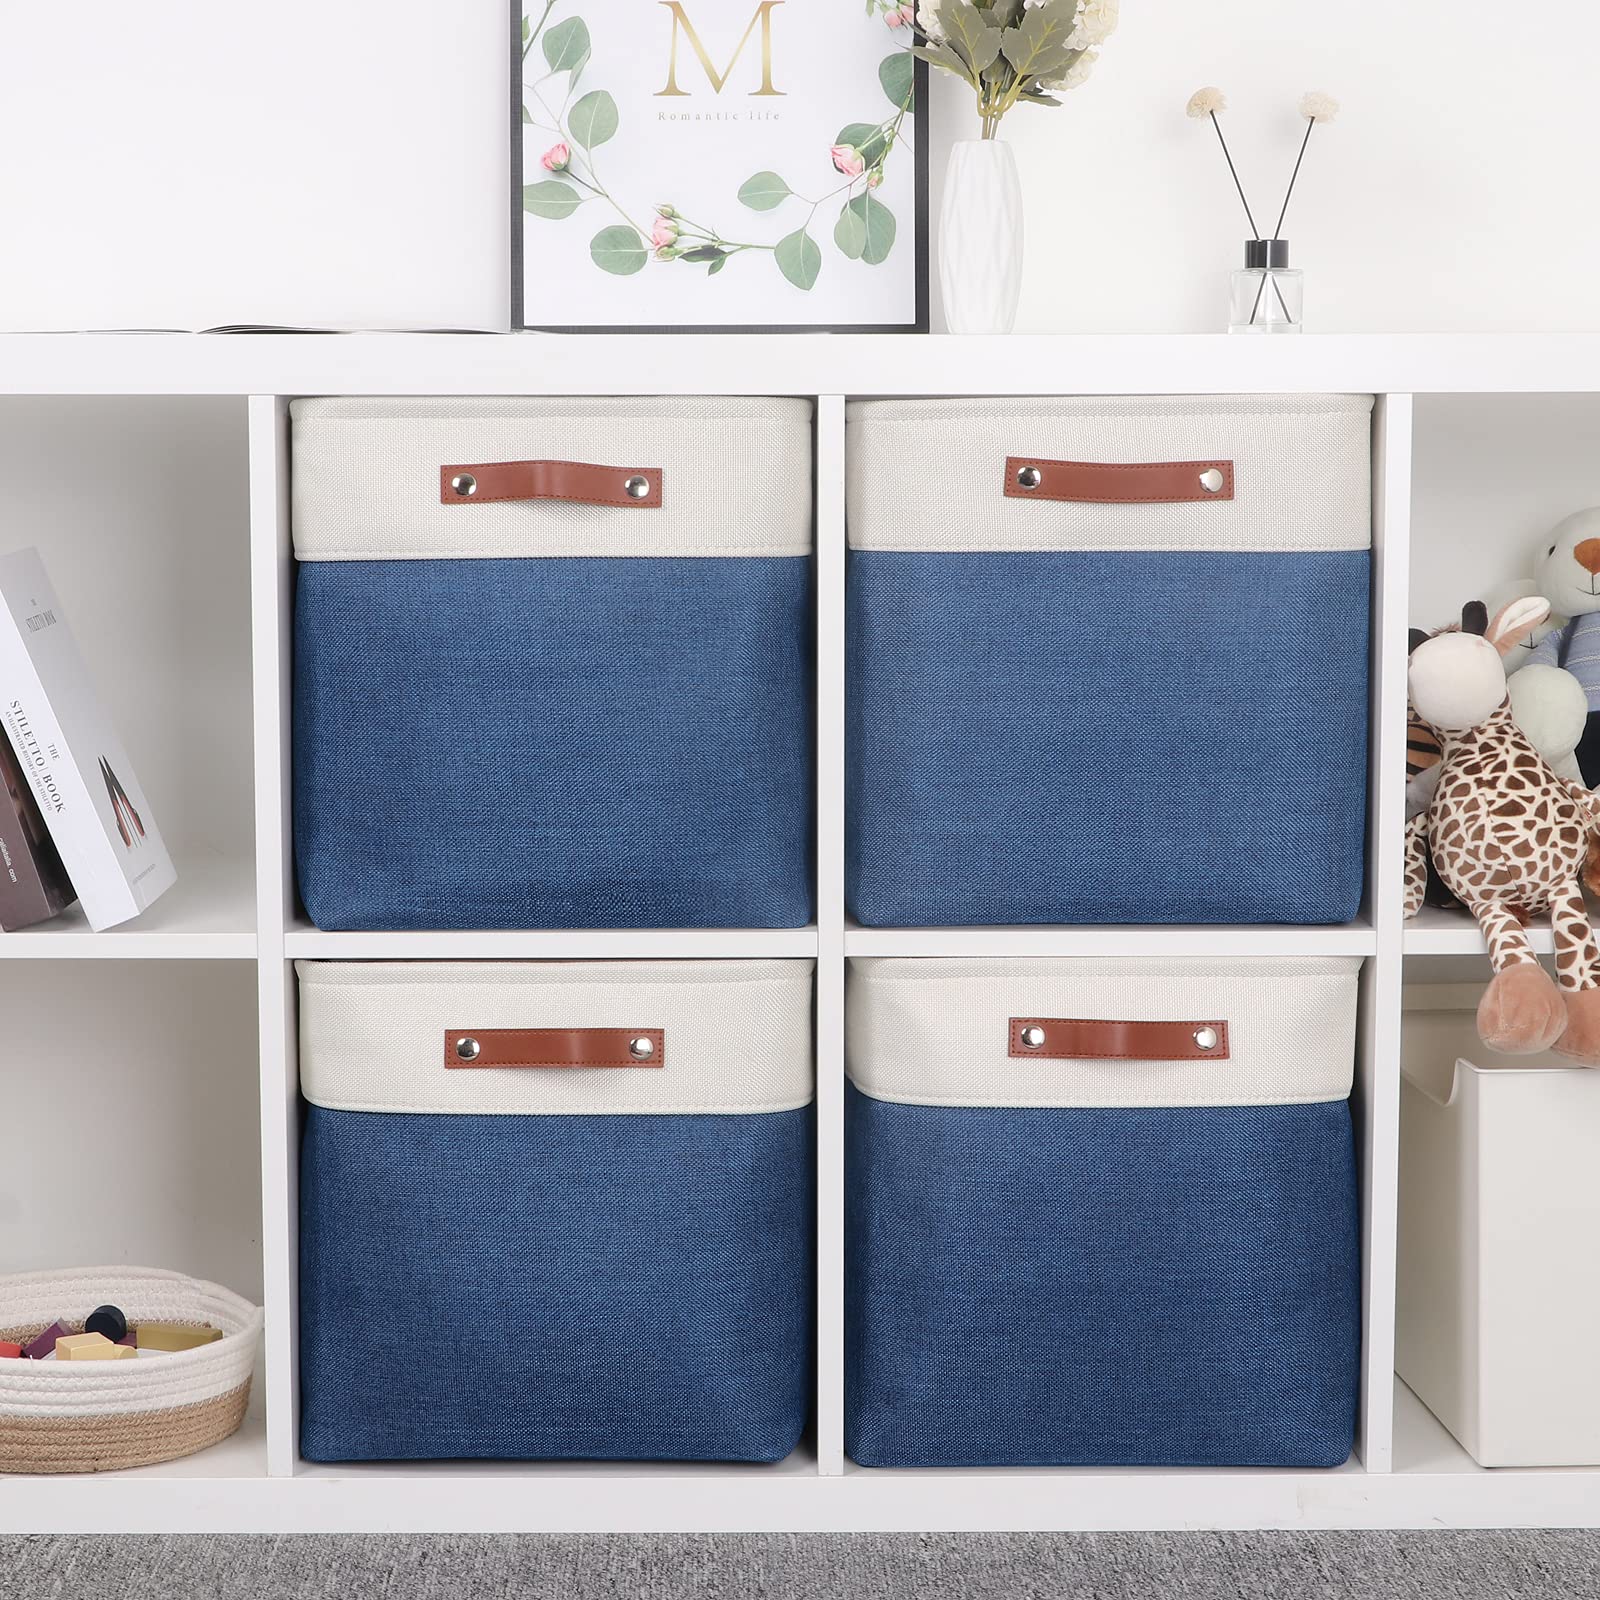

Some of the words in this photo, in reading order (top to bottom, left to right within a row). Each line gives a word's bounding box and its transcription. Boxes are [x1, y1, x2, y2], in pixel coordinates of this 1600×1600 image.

[653, 1, 787, 95] M
[658, 111, 738, 120] Romantic
[750, 110, 780, 120] life
[10, 700, 45, 766] STILETTO
[43, 774, 66, 813] BOOK
[48, 743, 60, 760] THE
